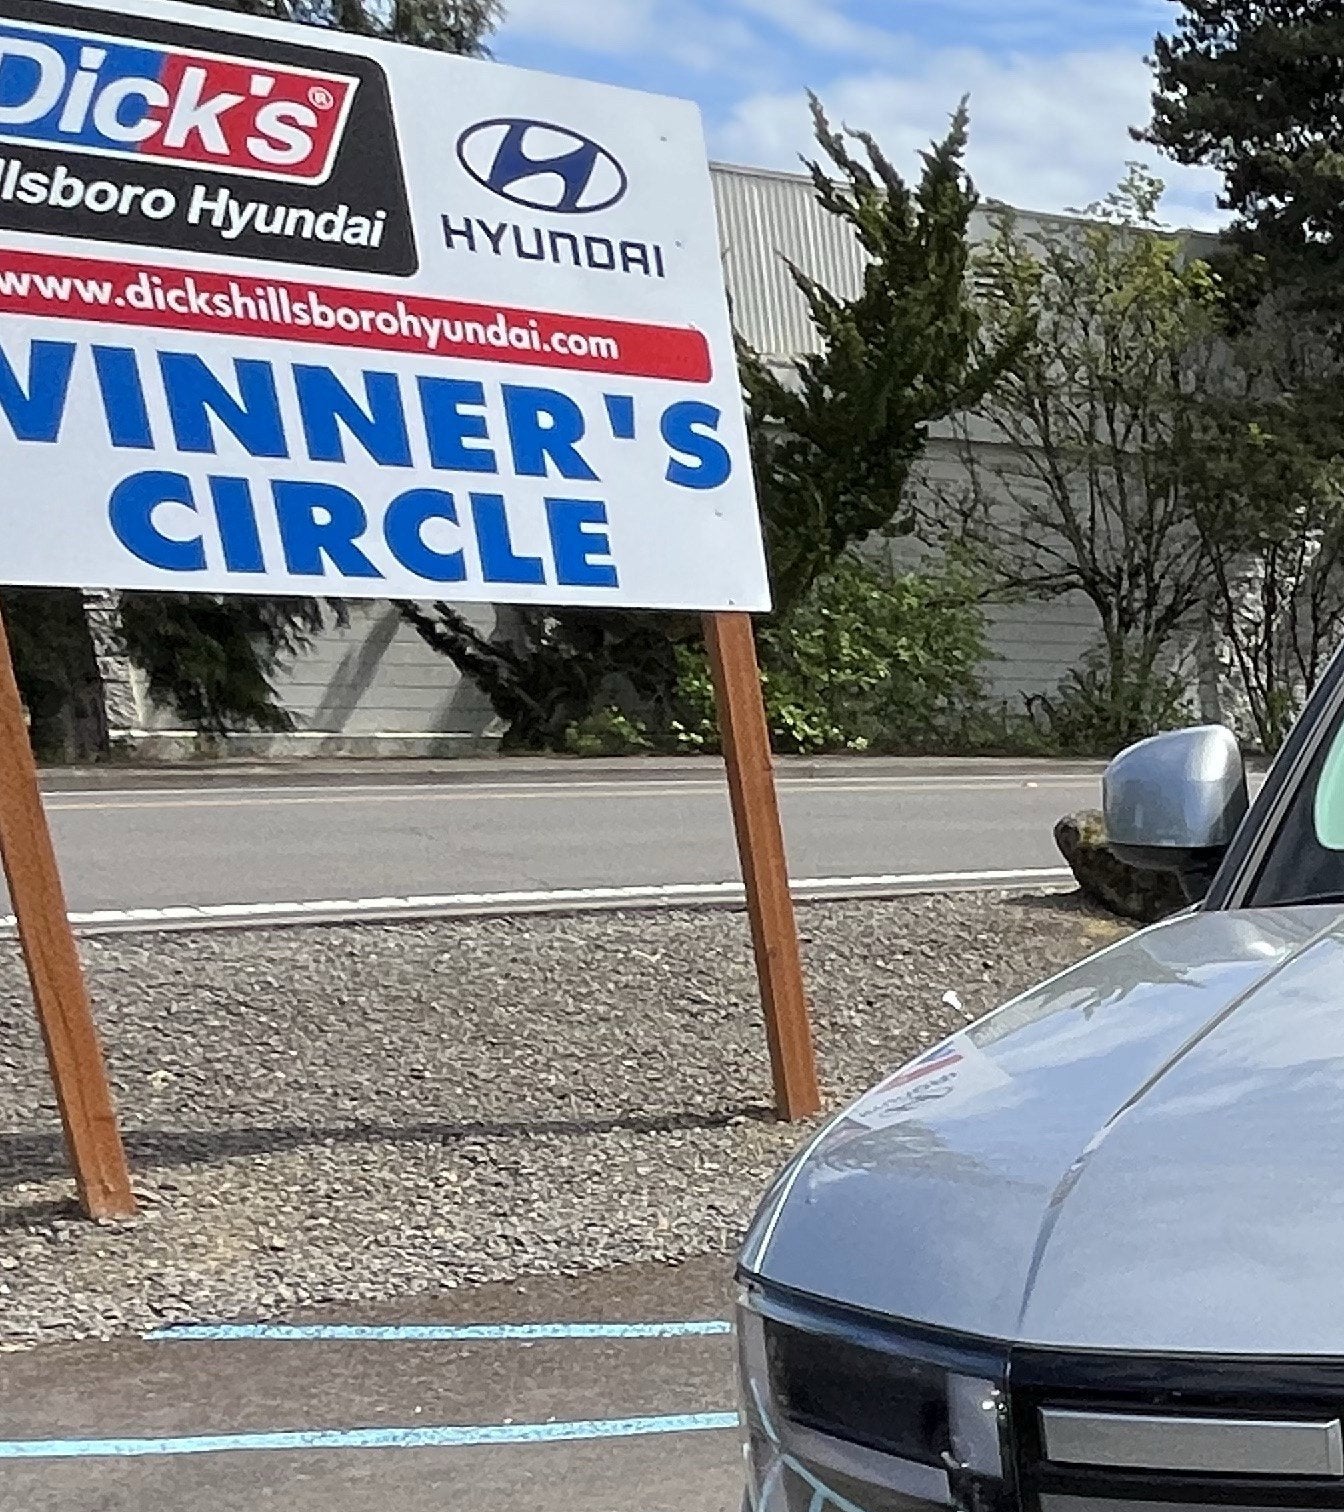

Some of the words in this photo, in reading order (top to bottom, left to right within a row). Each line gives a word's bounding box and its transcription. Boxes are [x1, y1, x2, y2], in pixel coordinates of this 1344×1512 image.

[0, 158, 176, 220] lsboro
[187, 184, 386, 248] Hyundai
[441, 214, 664, 278] HYUNDAI
[0, 270, 619, 360] www.dickshillsborohyundai.com
[108, 471, 618, 588] CIRCLE
